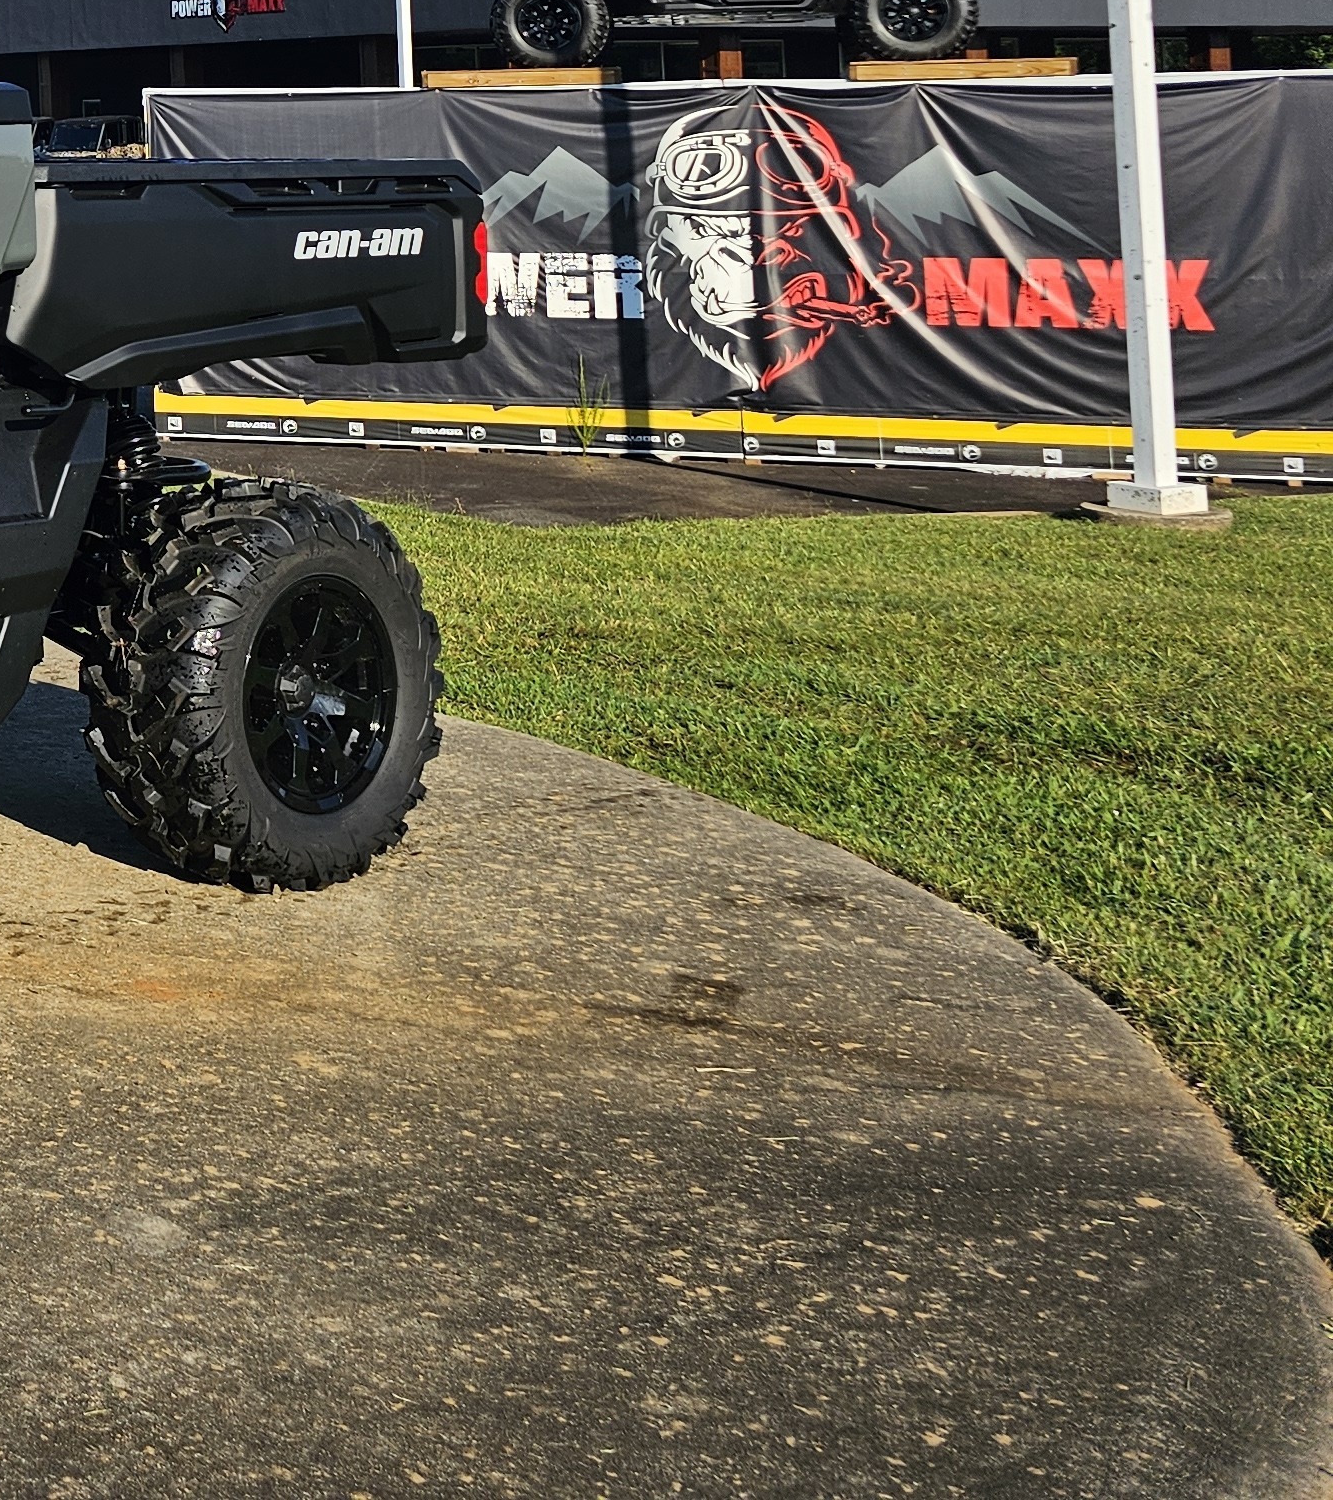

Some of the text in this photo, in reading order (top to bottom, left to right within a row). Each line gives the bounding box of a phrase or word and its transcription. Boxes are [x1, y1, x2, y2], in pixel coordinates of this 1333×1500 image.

[293, 227, 424, 260] can-am
[485, 252, 1216, 331] WER MAXX
